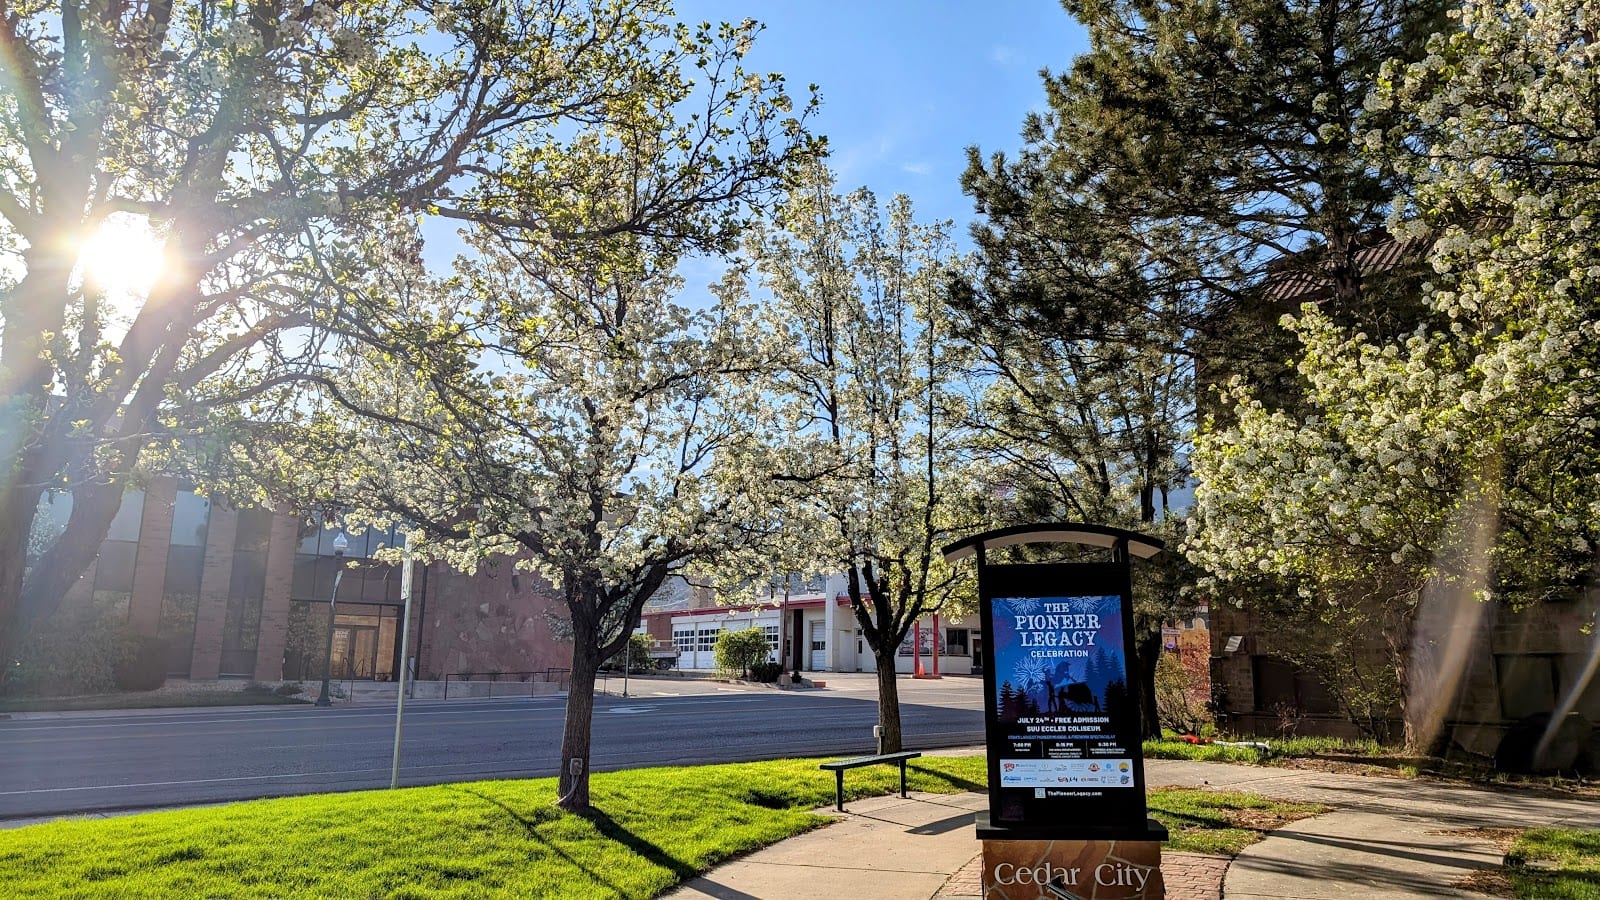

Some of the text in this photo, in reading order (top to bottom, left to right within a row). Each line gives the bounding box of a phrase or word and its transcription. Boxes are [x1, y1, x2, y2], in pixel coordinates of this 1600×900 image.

[1044, 603, 1069, 613] THE
[1014, 614, 1101, 630] PIONEER
[1020, 631, 1096, 647] LEGACY
[1031, 650, 1089, 658] CELEBRATION
[994, 862, 1151, 892] Cedar City
